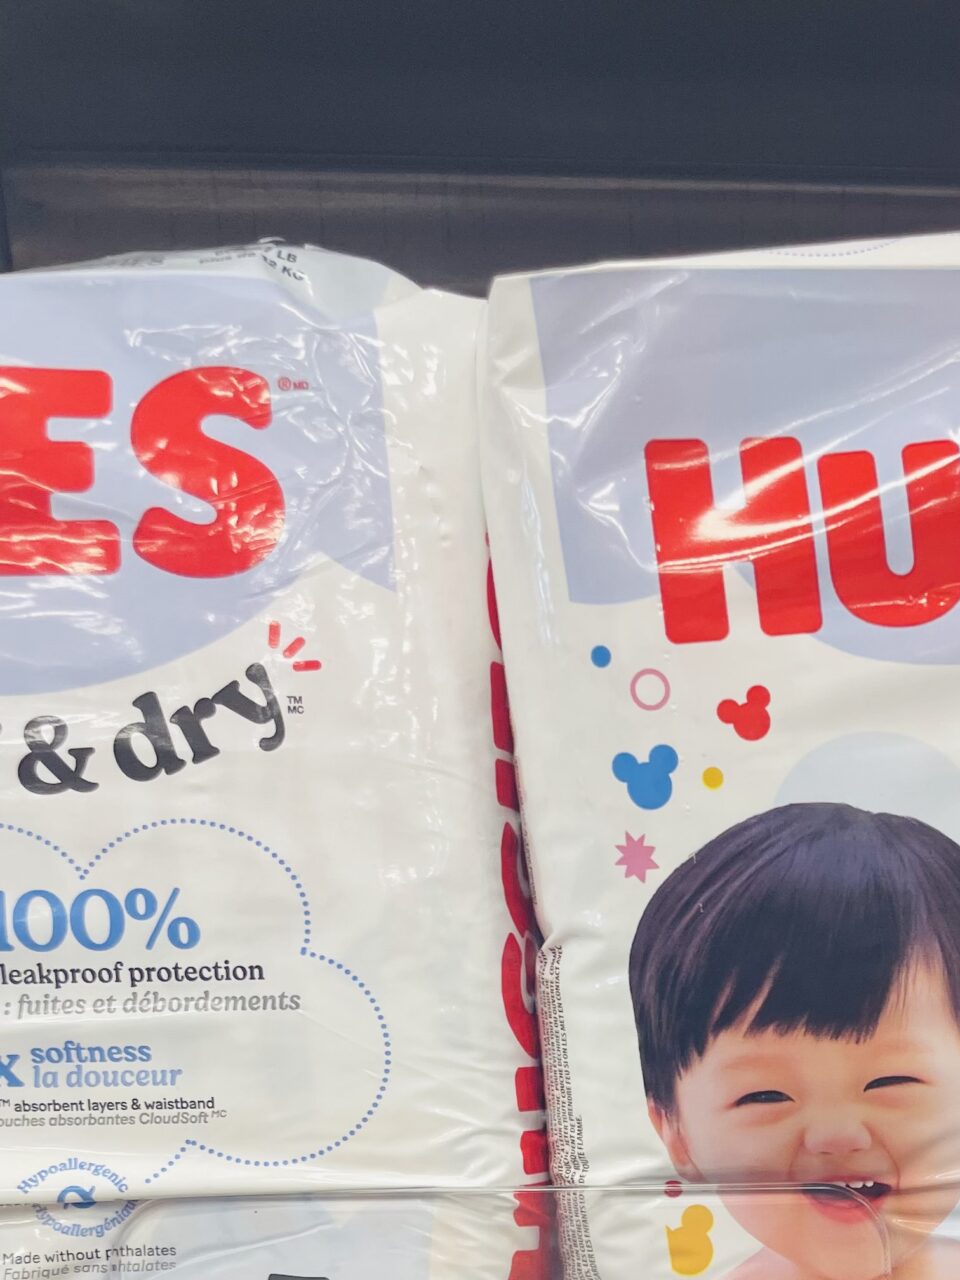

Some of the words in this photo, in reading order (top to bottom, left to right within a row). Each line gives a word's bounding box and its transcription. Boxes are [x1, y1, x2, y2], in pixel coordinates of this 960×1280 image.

[17, 715, 100, 795] &
[113, 662, 287, 782] dry
[129, 959, 266, 988] protection
[17, 994, 87, 1021] fuites
[92, 994, 117, 1015] et
[122, 989, 301, 1016] débordements
[30, 1040, 153, 1064] softness
[32, 1065, 61, 1089] la
[65, 1065, 184, 1088] douceur
[14, 1098, 84, 1113] absorbent
[87, 1097, 128, 1115] layers
[131, 1098, 142, 1111] &
[144, 1096, 216, 1111] waistband
[48, 1112, 136, 1127] absorbantes
[139, 1110, 209, 1126] CloudSoft
[17, 1157, 129, 1195] Hypoallergenic
[3, 1251, 41, 1266] Made
[44, 1248, 101, 1263] without
[3, 1265, 70, 1280] Fabriqué
[73, 1263, 108, 1274] sans
